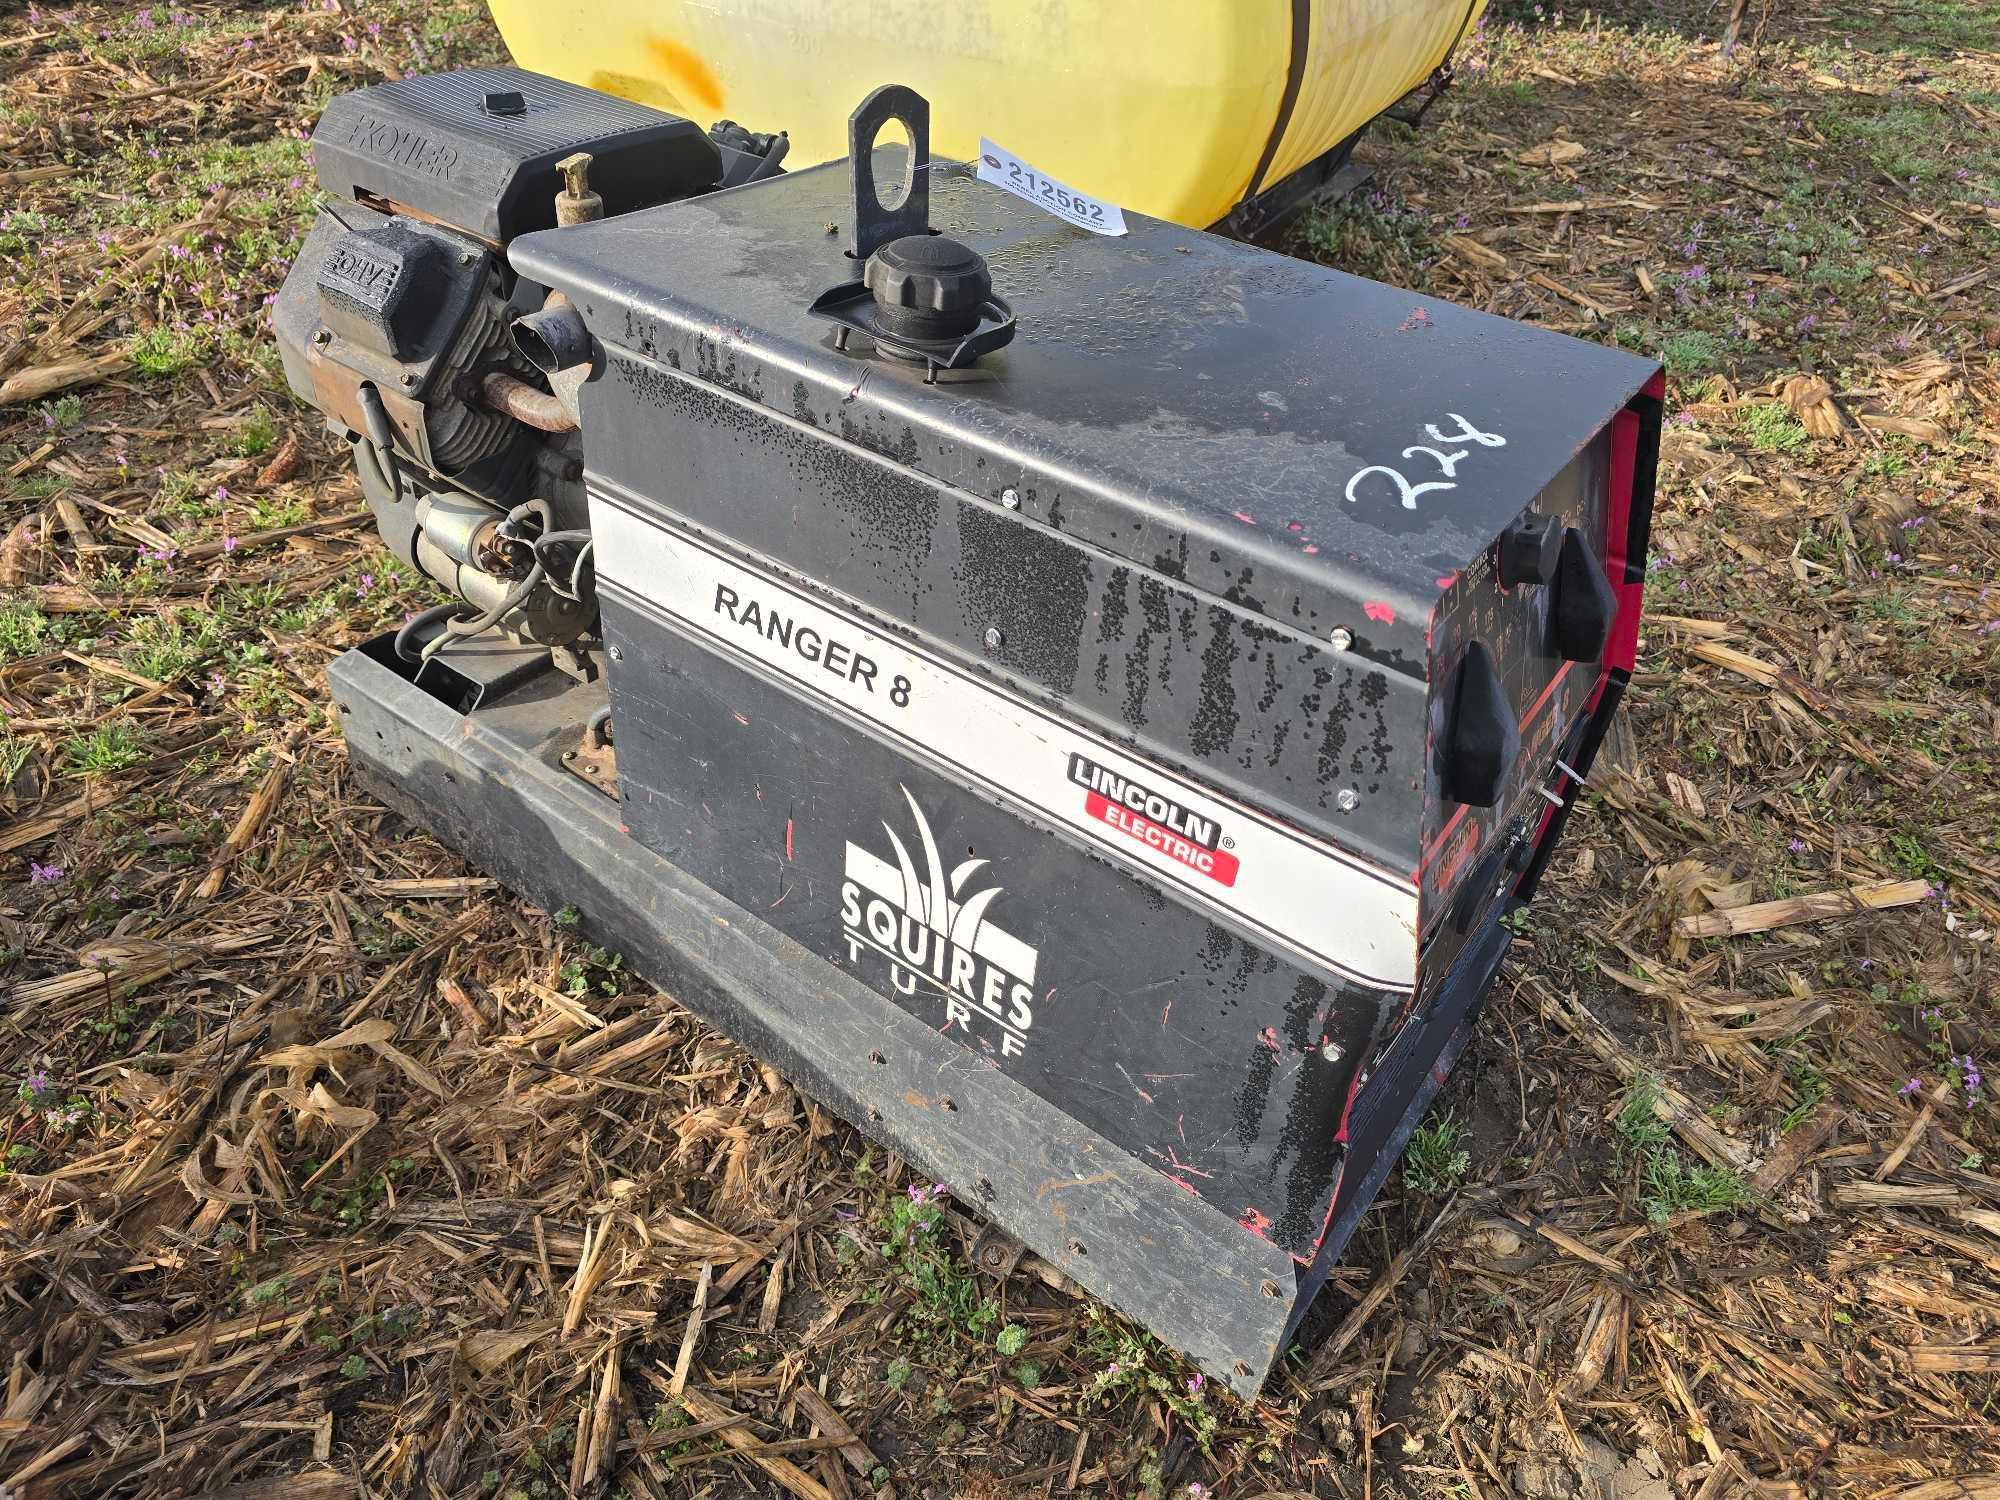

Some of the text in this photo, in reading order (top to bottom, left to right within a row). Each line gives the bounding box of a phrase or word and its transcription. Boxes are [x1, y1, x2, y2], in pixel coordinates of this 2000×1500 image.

[349, 114, 458, 181] KOHLER
[1008, 161, 1105, 223] 212562
[340, 252, 384, 287] OHV
[713, 583, 913, 709] RANGER 8
[1074, 758, 1213, 847] LINCOLN
[1104, 803, 1215, 873] ELECTRIC
[840, 881, 1034, 1030] SQUIRES
[843, 932, 1027, 1057] TURF
